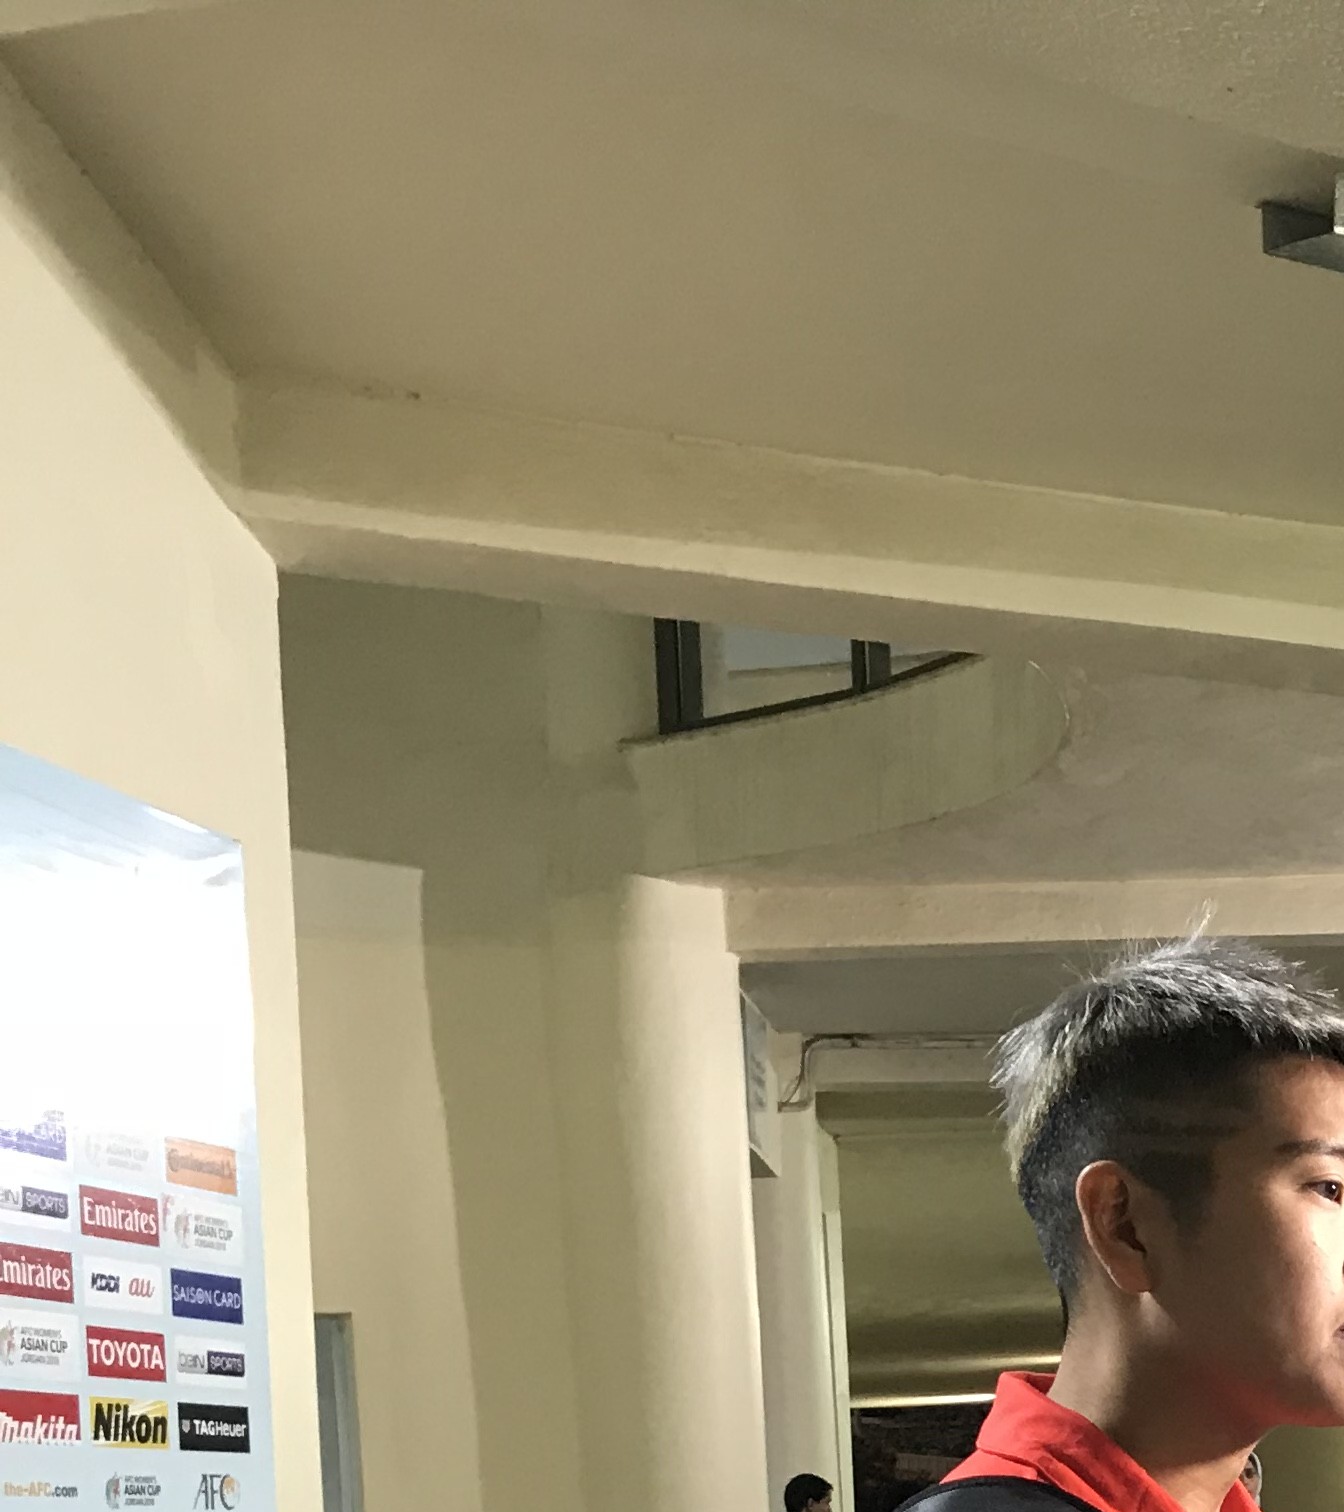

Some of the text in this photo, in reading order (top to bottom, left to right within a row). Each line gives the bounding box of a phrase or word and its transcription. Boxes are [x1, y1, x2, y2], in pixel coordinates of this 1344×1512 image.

[25, 1191, 66, 1214] SPORTS
[83, 1196, 158, 1236] Emirates
[0, 1255, 71, 1290] mirates
[173, 1284, 242, 1309] SAISON CARD
[20, 1337, 68, 1353] ASIAN CUP
[88, 1338, 165, 1371] TOYOTA
[210, 1355, 243, 1373] SPORTS
[0, 1412, 79, 1446] makita
[93, 1402, 169, 1444] Nikon
[4, 1481, 79, 1498] the-AFC.com
[124, 1484, 162, 1496] ASIAN CUP
[192, 1473, 241, 1511] AFC
